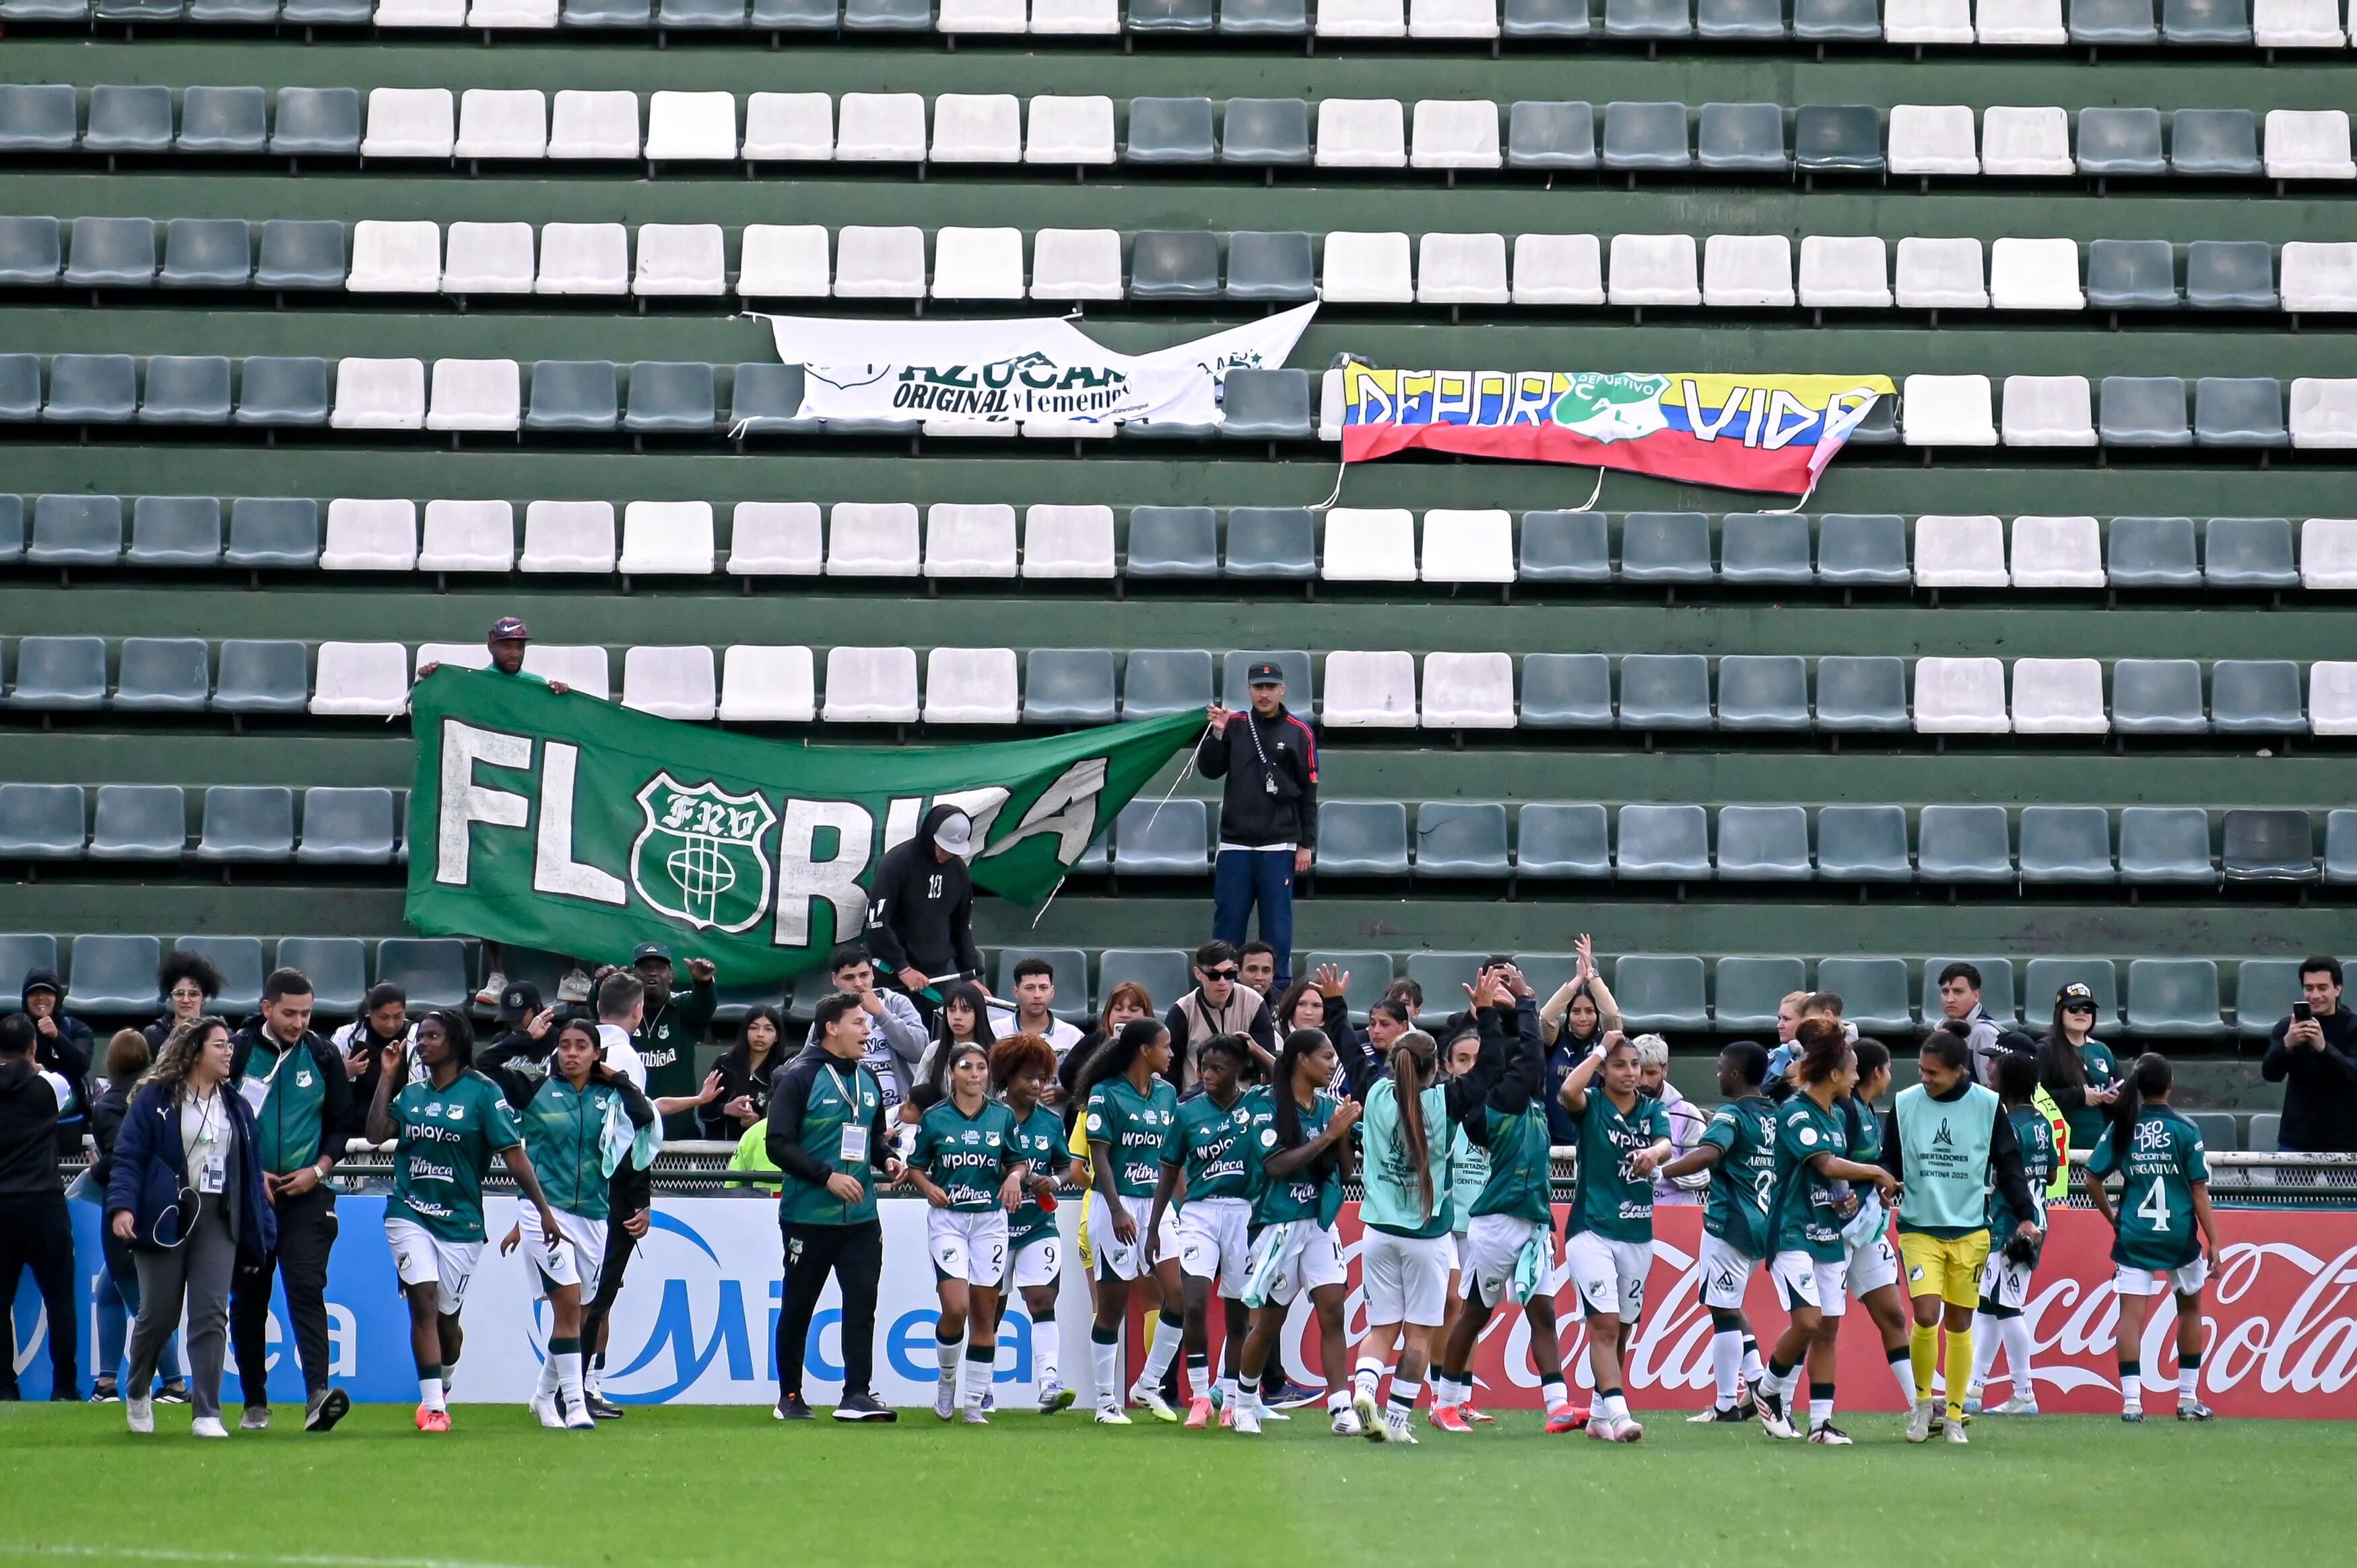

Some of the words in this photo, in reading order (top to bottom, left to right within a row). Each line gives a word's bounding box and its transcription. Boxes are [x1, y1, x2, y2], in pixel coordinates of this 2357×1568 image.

[893, 382, 1010, 414] ORIGINAL
[927, 874, 943, 899] 10
[2133, 1120, 2163, 1140] DEO
[2140, 1132, 2171, 1153] PIES
[1951, 1171, 1969, 1180] 2025
[2137, 1175, 2171, 1231] 4
[991, 1244, 1003, 1264] 2
[1044, 1246, 1055, 1264] 9
[455, 1274, 470, 1294] 17
